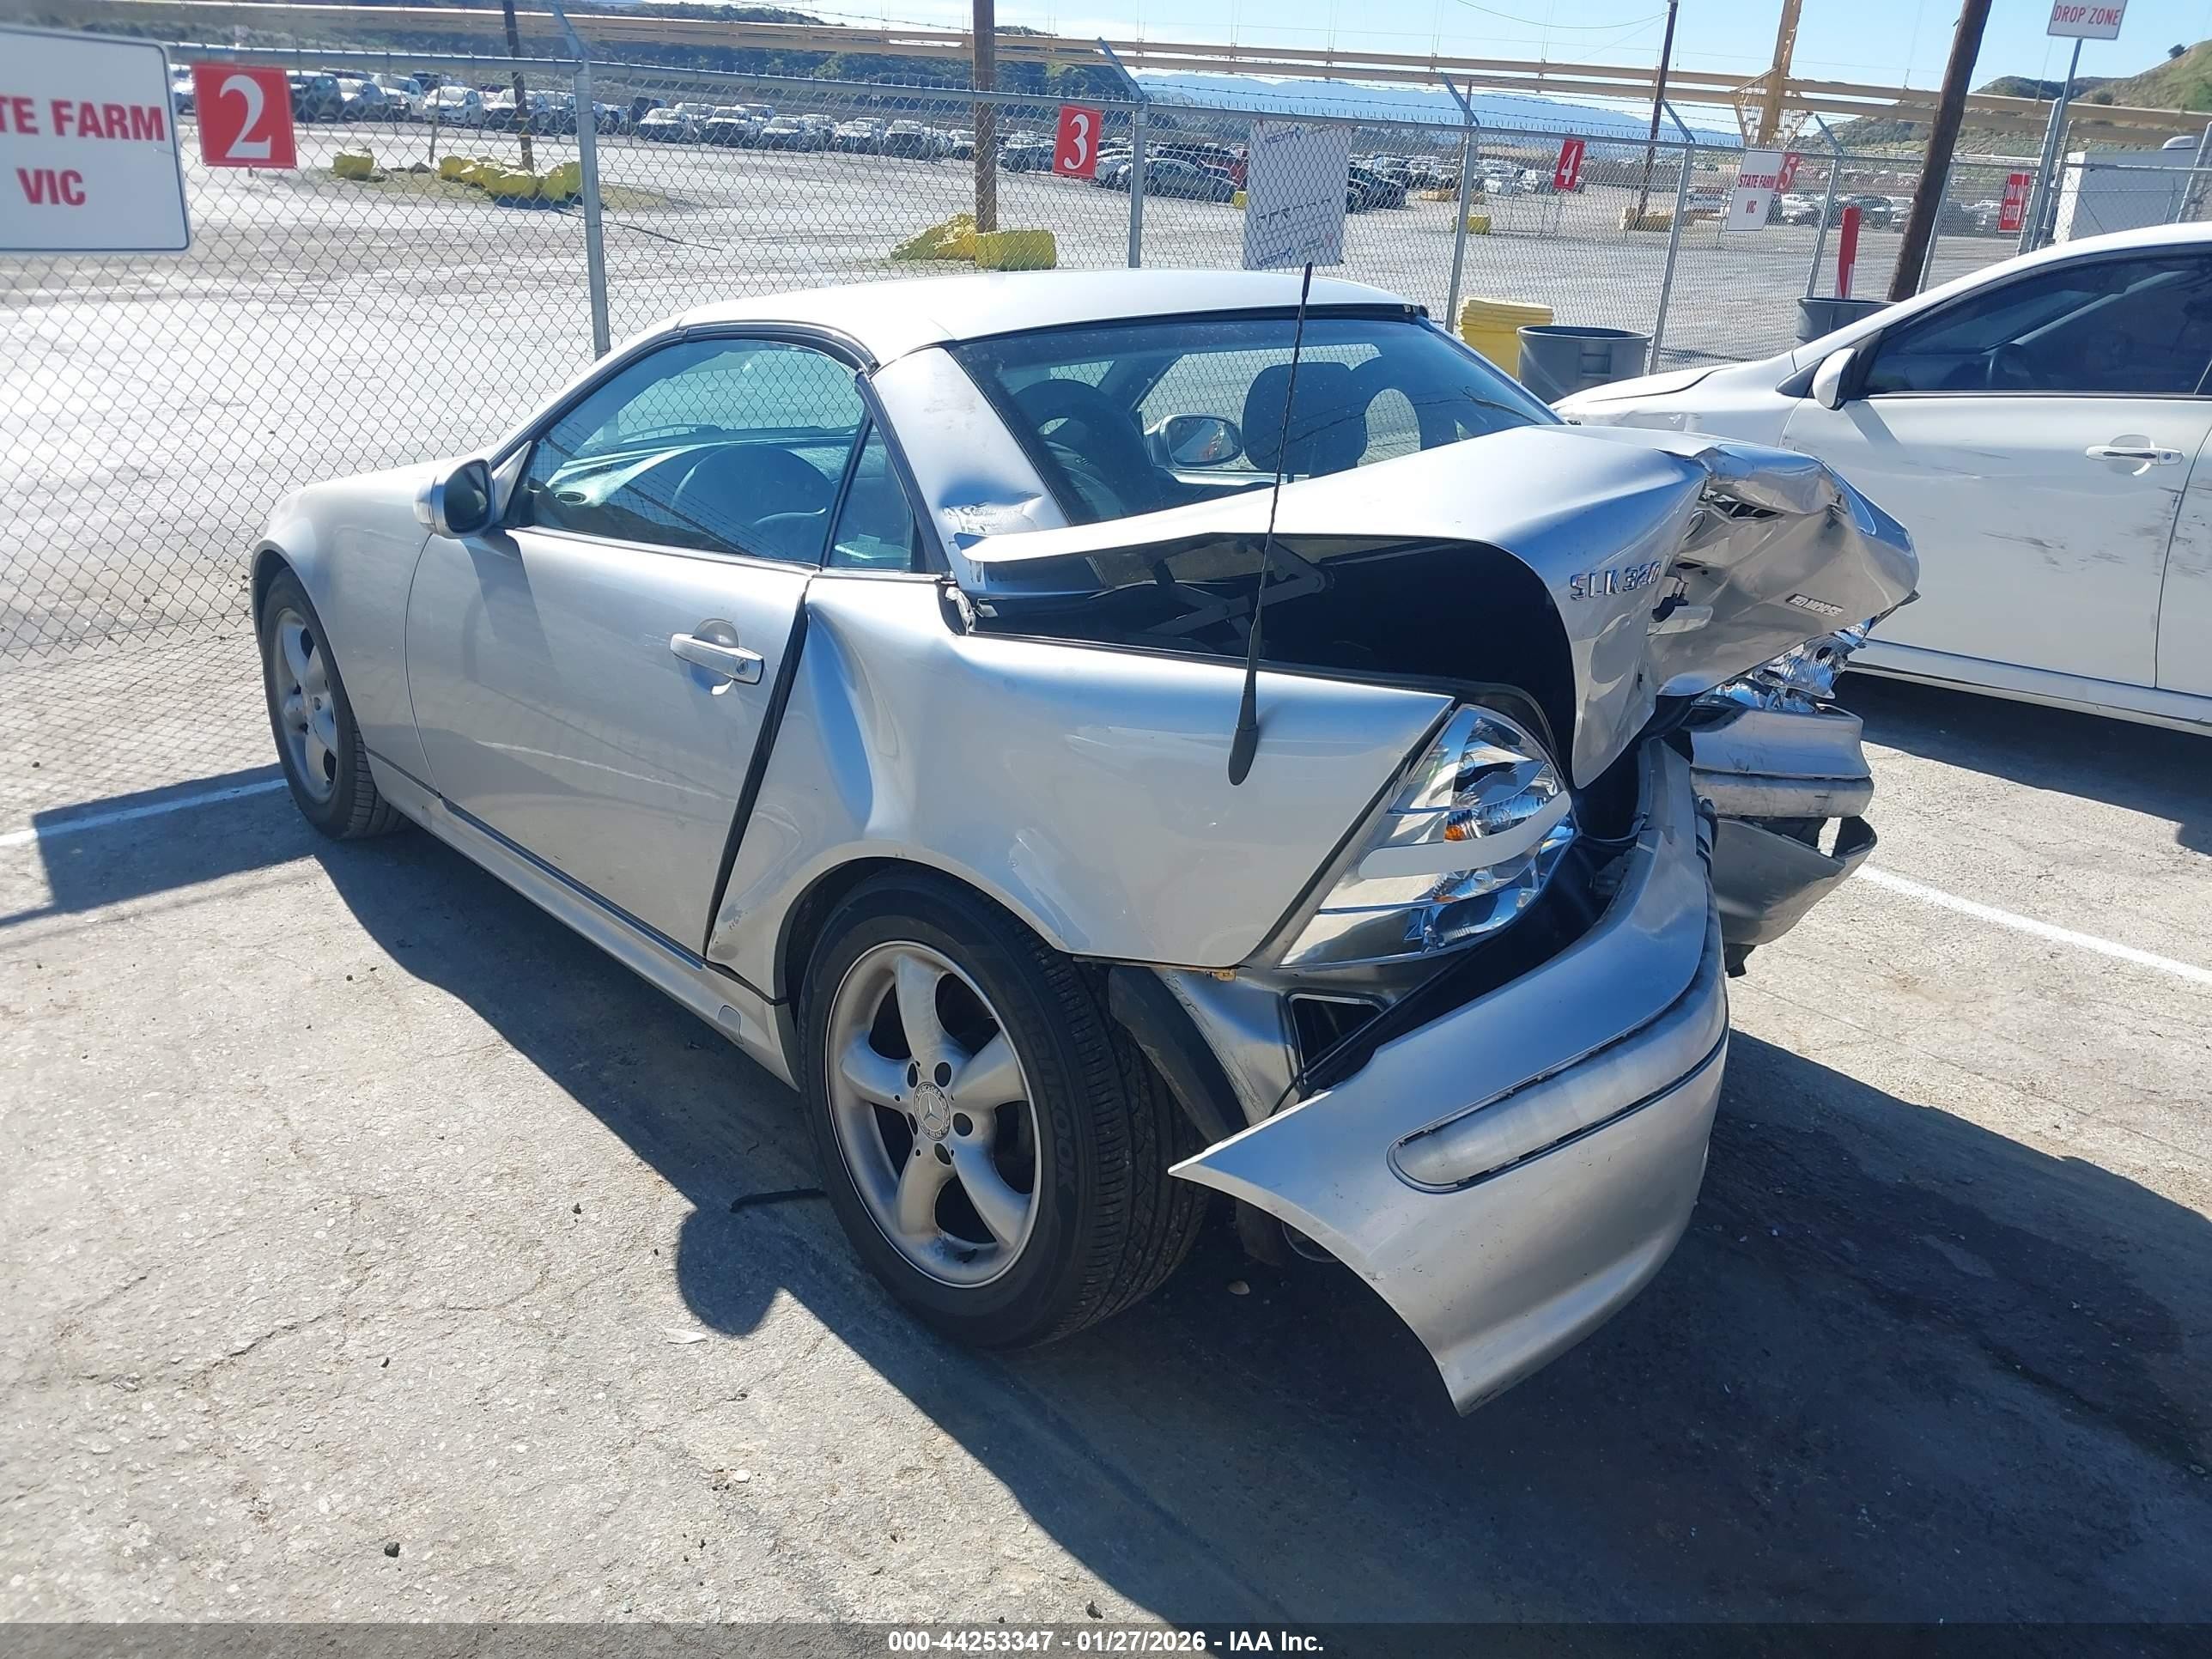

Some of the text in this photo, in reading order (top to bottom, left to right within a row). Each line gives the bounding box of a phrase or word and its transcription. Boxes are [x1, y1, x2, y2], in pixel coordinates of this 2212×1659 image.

[2053, 5, 2121, 25] DROP ZONE
[50, 99, 165, 141] FARM
[220, 74, 272, 159] 2
[1064, 113, 1089, 169] 3
[1560, 144, 1578, 185] 4
[1738, 173, 1776, 188] STATE FARM
[1778, 156, 1797, 189] 5
[16, 167, 87, 206] VIC
[1746, 199, 1757, 214] VIC
[1570, 561, 1662, 600] SLK 320
